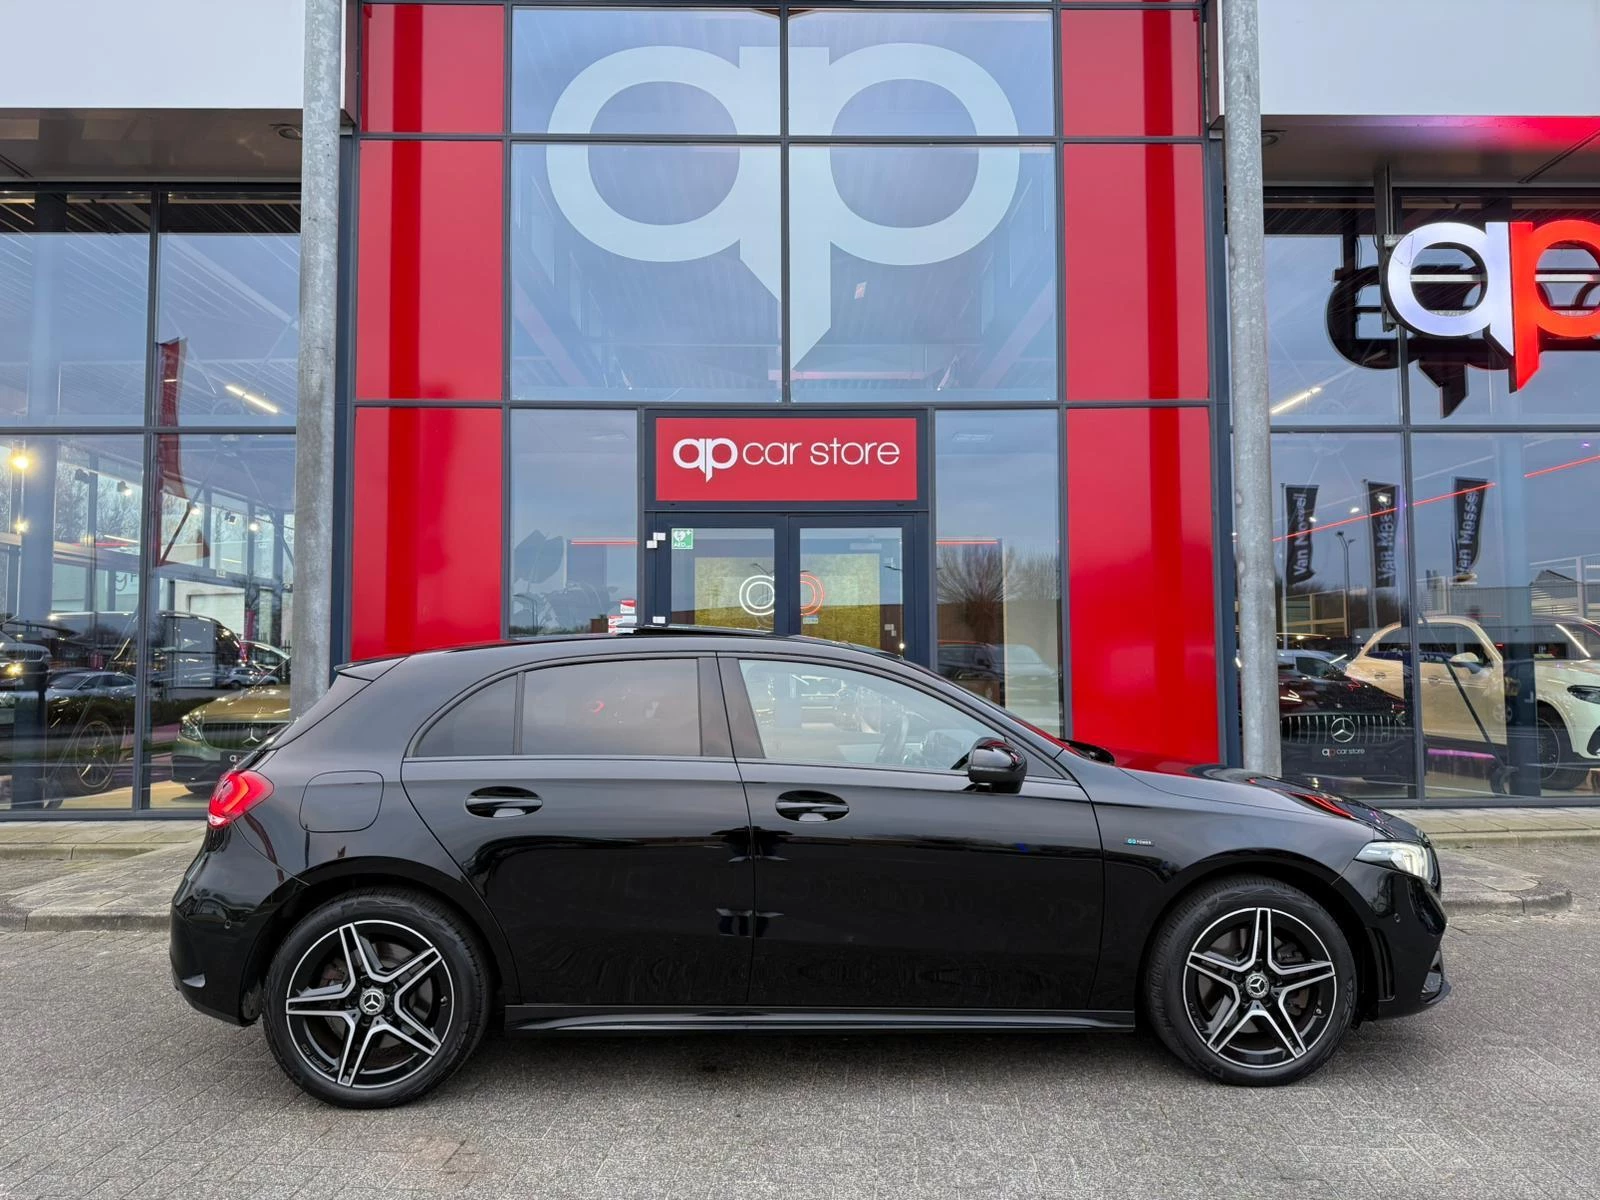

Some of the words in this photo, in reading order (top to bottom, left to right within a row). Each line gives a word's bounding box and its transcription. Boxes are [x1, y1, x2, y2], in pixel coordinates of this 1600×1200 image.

[546, 43, 1020, 369] ap
[1387, 219, 1600, 392] ap
[673, 437, 738, 483] ap
[742, 442, 802, 465] car
[810, 437, 900, 465] store
[1293, 549, 1309, 576] Van
[1376, 551, 1396, 580] Van
